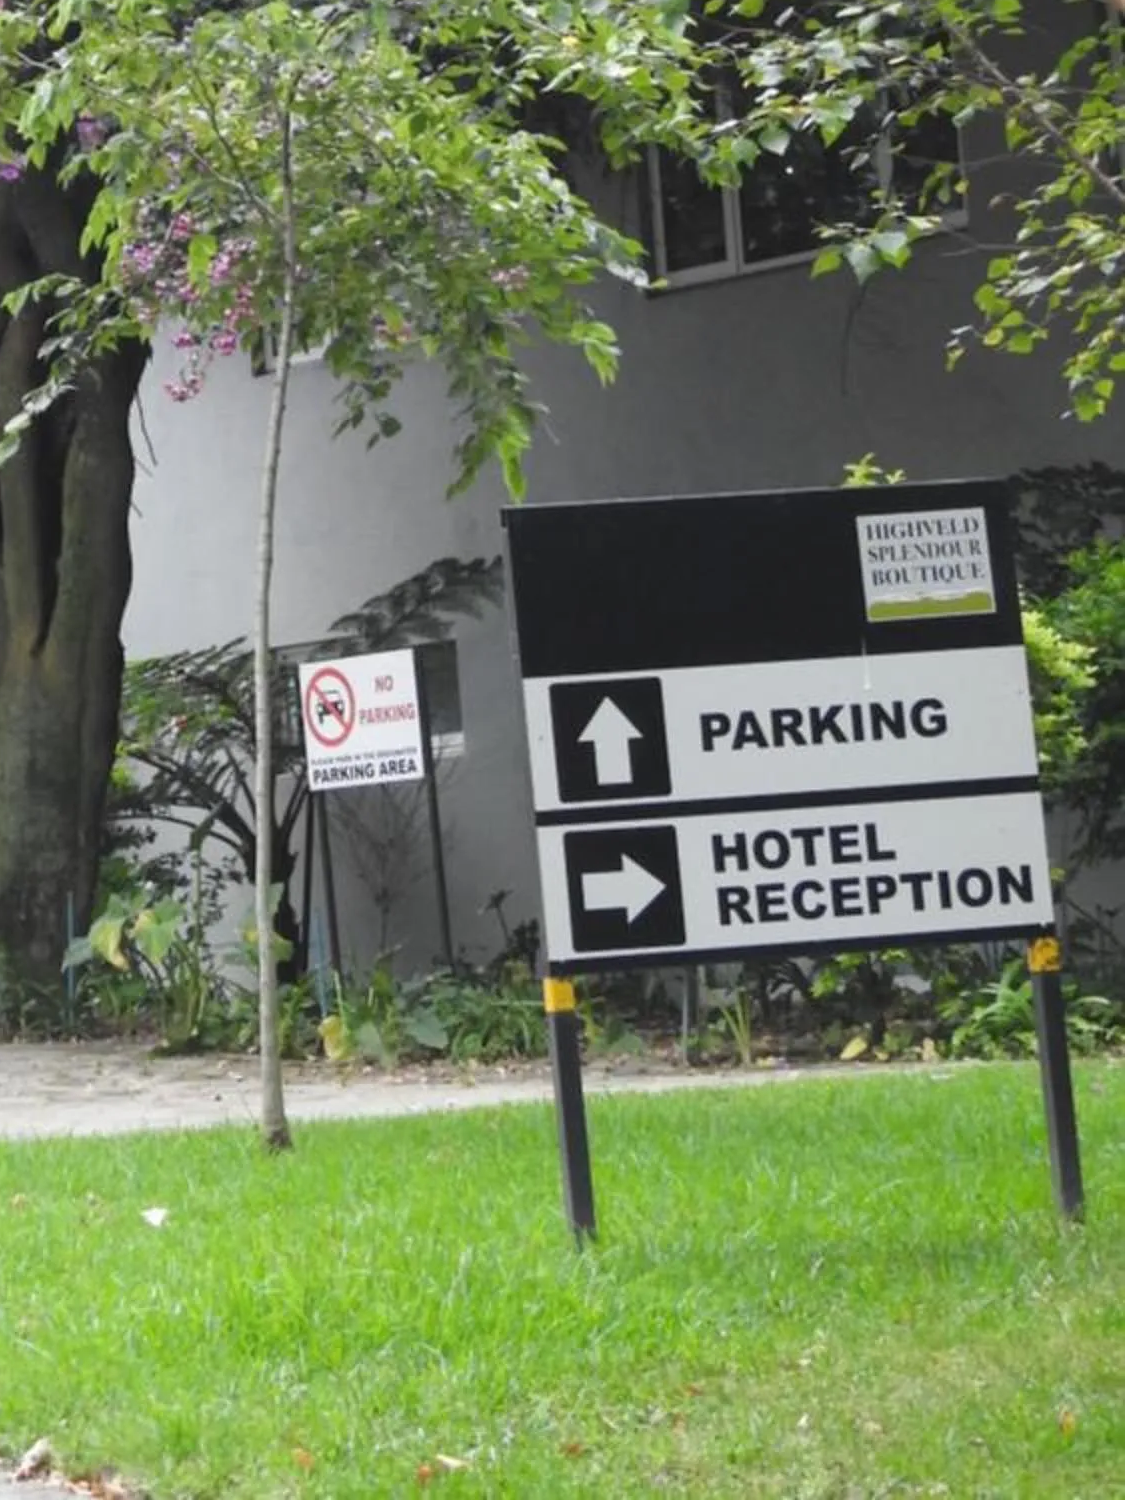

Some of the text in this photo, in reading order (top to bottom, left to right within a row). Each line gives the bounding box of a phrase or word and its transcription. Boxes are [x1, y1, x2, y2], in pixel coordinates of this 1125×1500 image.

[865, 516, 980, 541] HIGHVELD
[867, 539, 982, 562] SPLENDOUR
[872, 562, 985, 587] BOUTIQUE
[374, 675, 394, 693] NO
[359, 703, 416, 725] PARKING
[699, 698, 948, 752] PARKING
[312, 757, 417, 784] PARKING AREA
[711, 822, 897, 874] HOTEL
[717, 864, 1034, 926] RECEPTION
